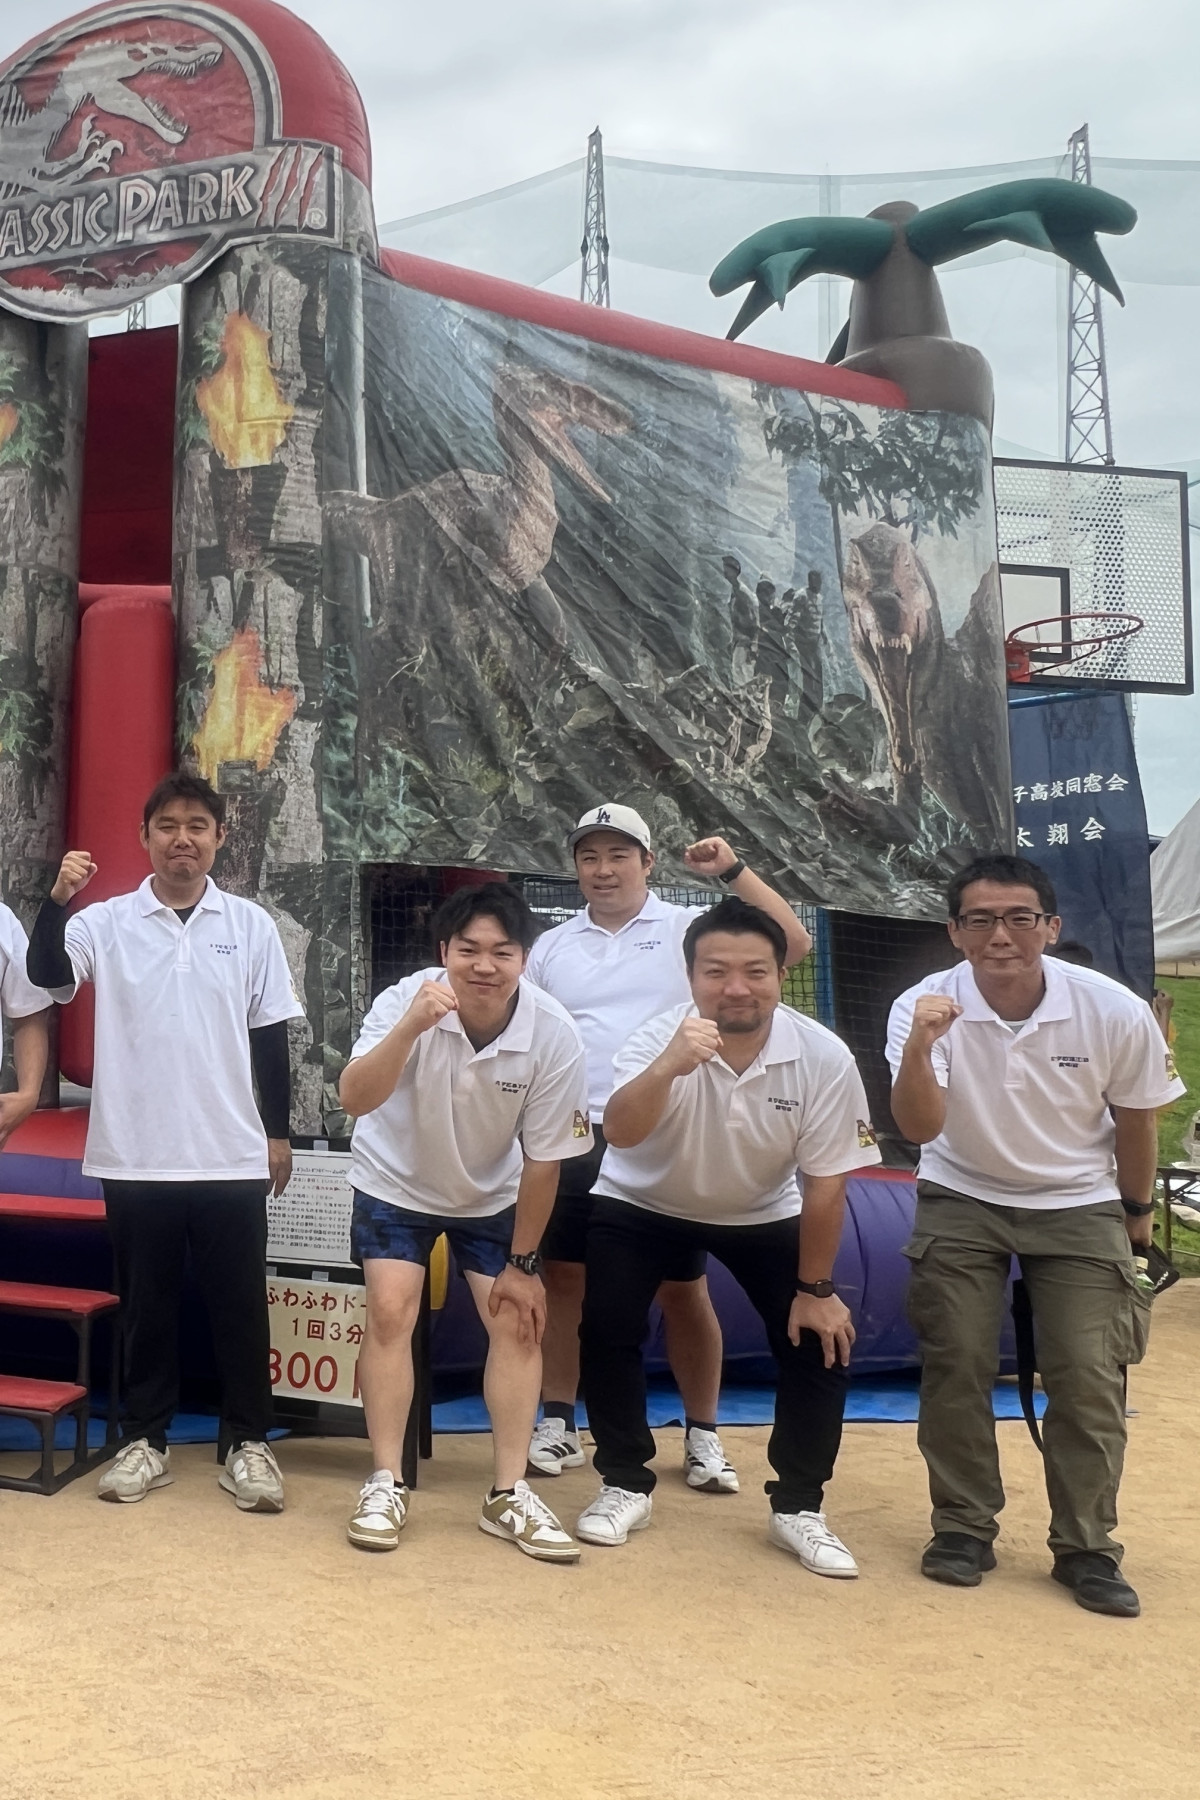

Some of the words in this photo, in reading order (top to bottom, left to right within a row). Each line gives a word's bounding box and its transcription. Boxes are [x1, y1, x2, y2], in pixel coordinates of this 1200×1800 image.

[116, 166, 255, 243] PARK
[596, 807, 611, 823] LA
[267, 1287, 366, 1313] ふわふわド
[292, 1317, 364, 1344] 1回3分
[270, 1348, 360, 1399] 300
